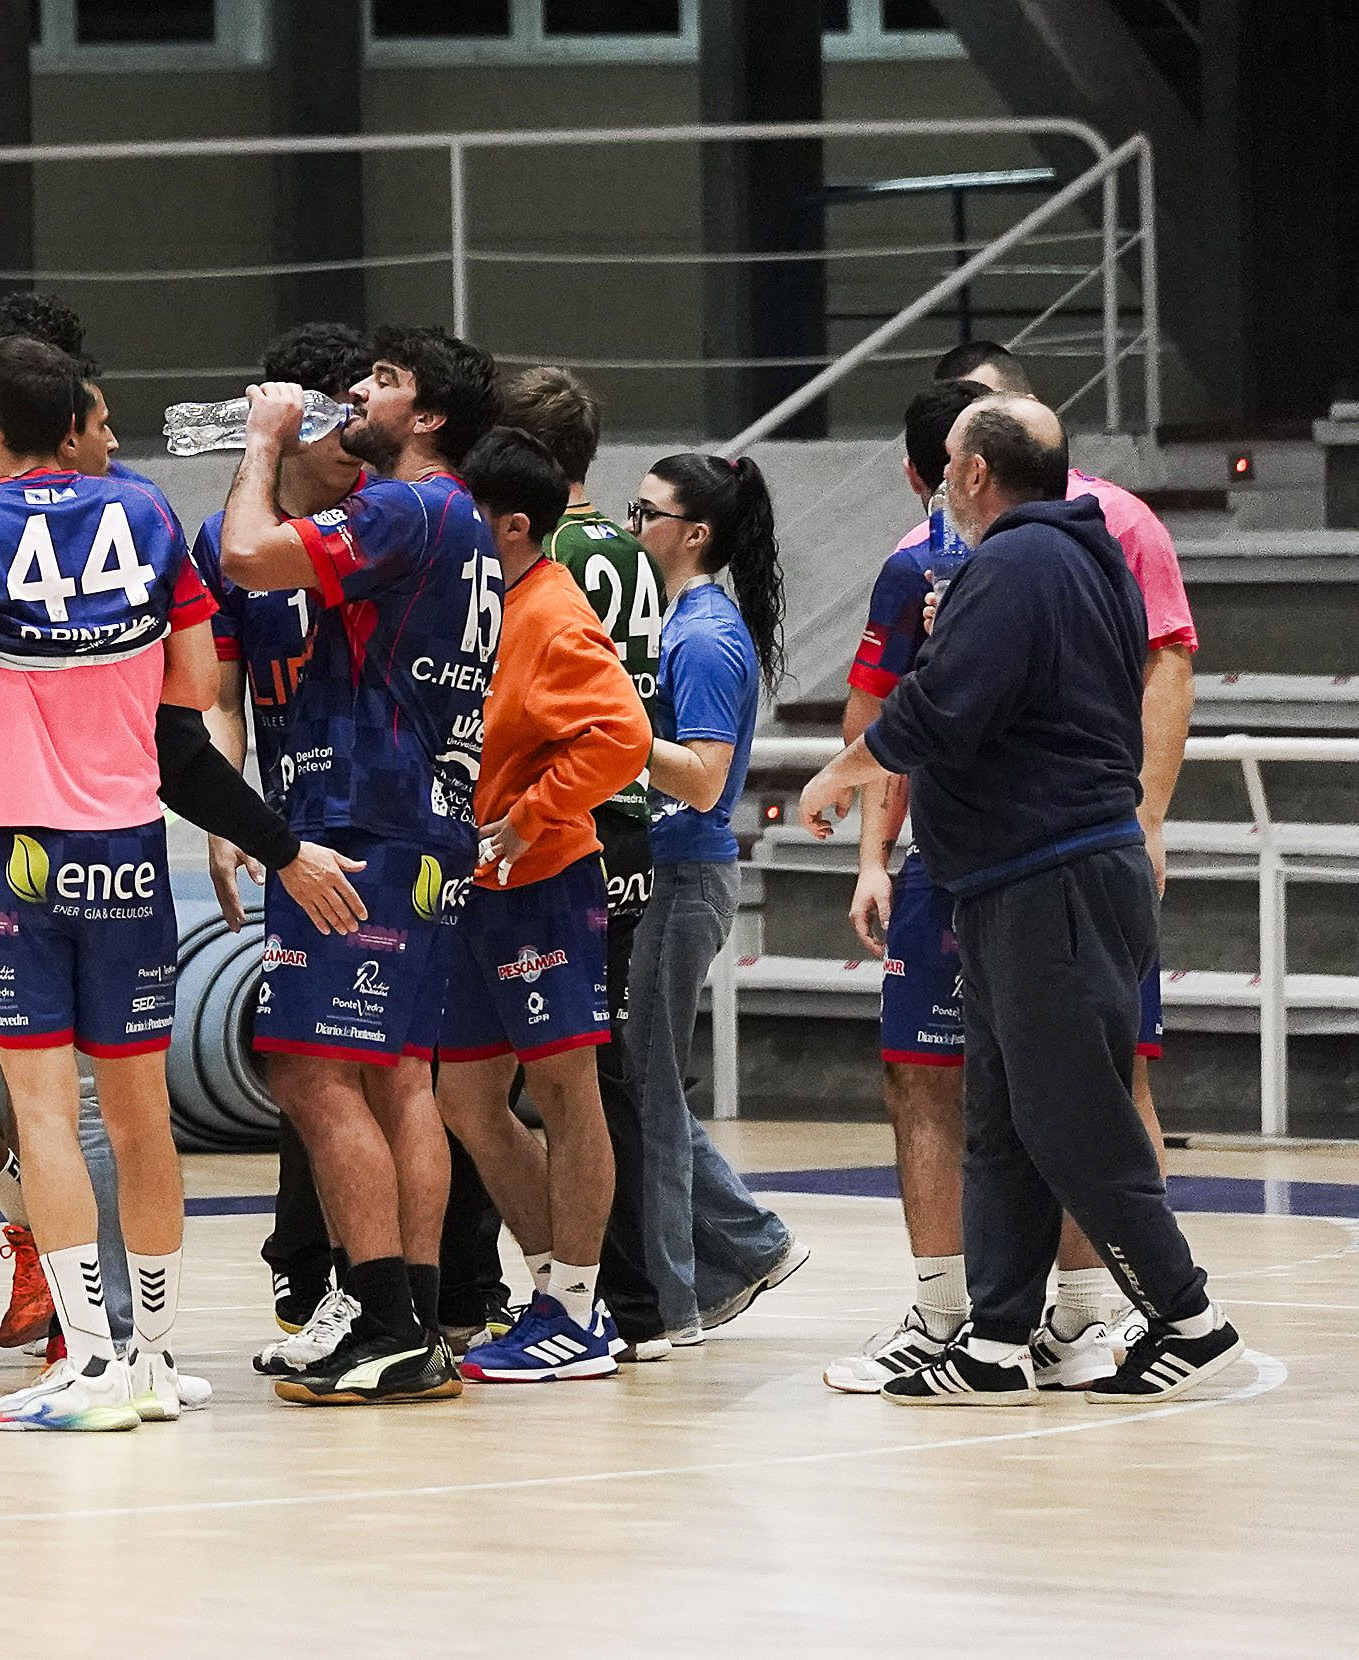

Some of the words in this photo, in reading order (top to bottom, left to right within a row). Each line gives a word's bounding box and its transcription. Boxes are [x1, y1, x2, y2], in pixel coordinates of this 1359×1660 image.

[7, 502, 156, 622] 44
[460, 548, 503, 662] 15
[585, 552, 664, 661] 24
[56, 861, 156, 901] ence
[498, 949, 568, 980] PESCAMAR
[529, 1014, 550, 1025] CIPA
